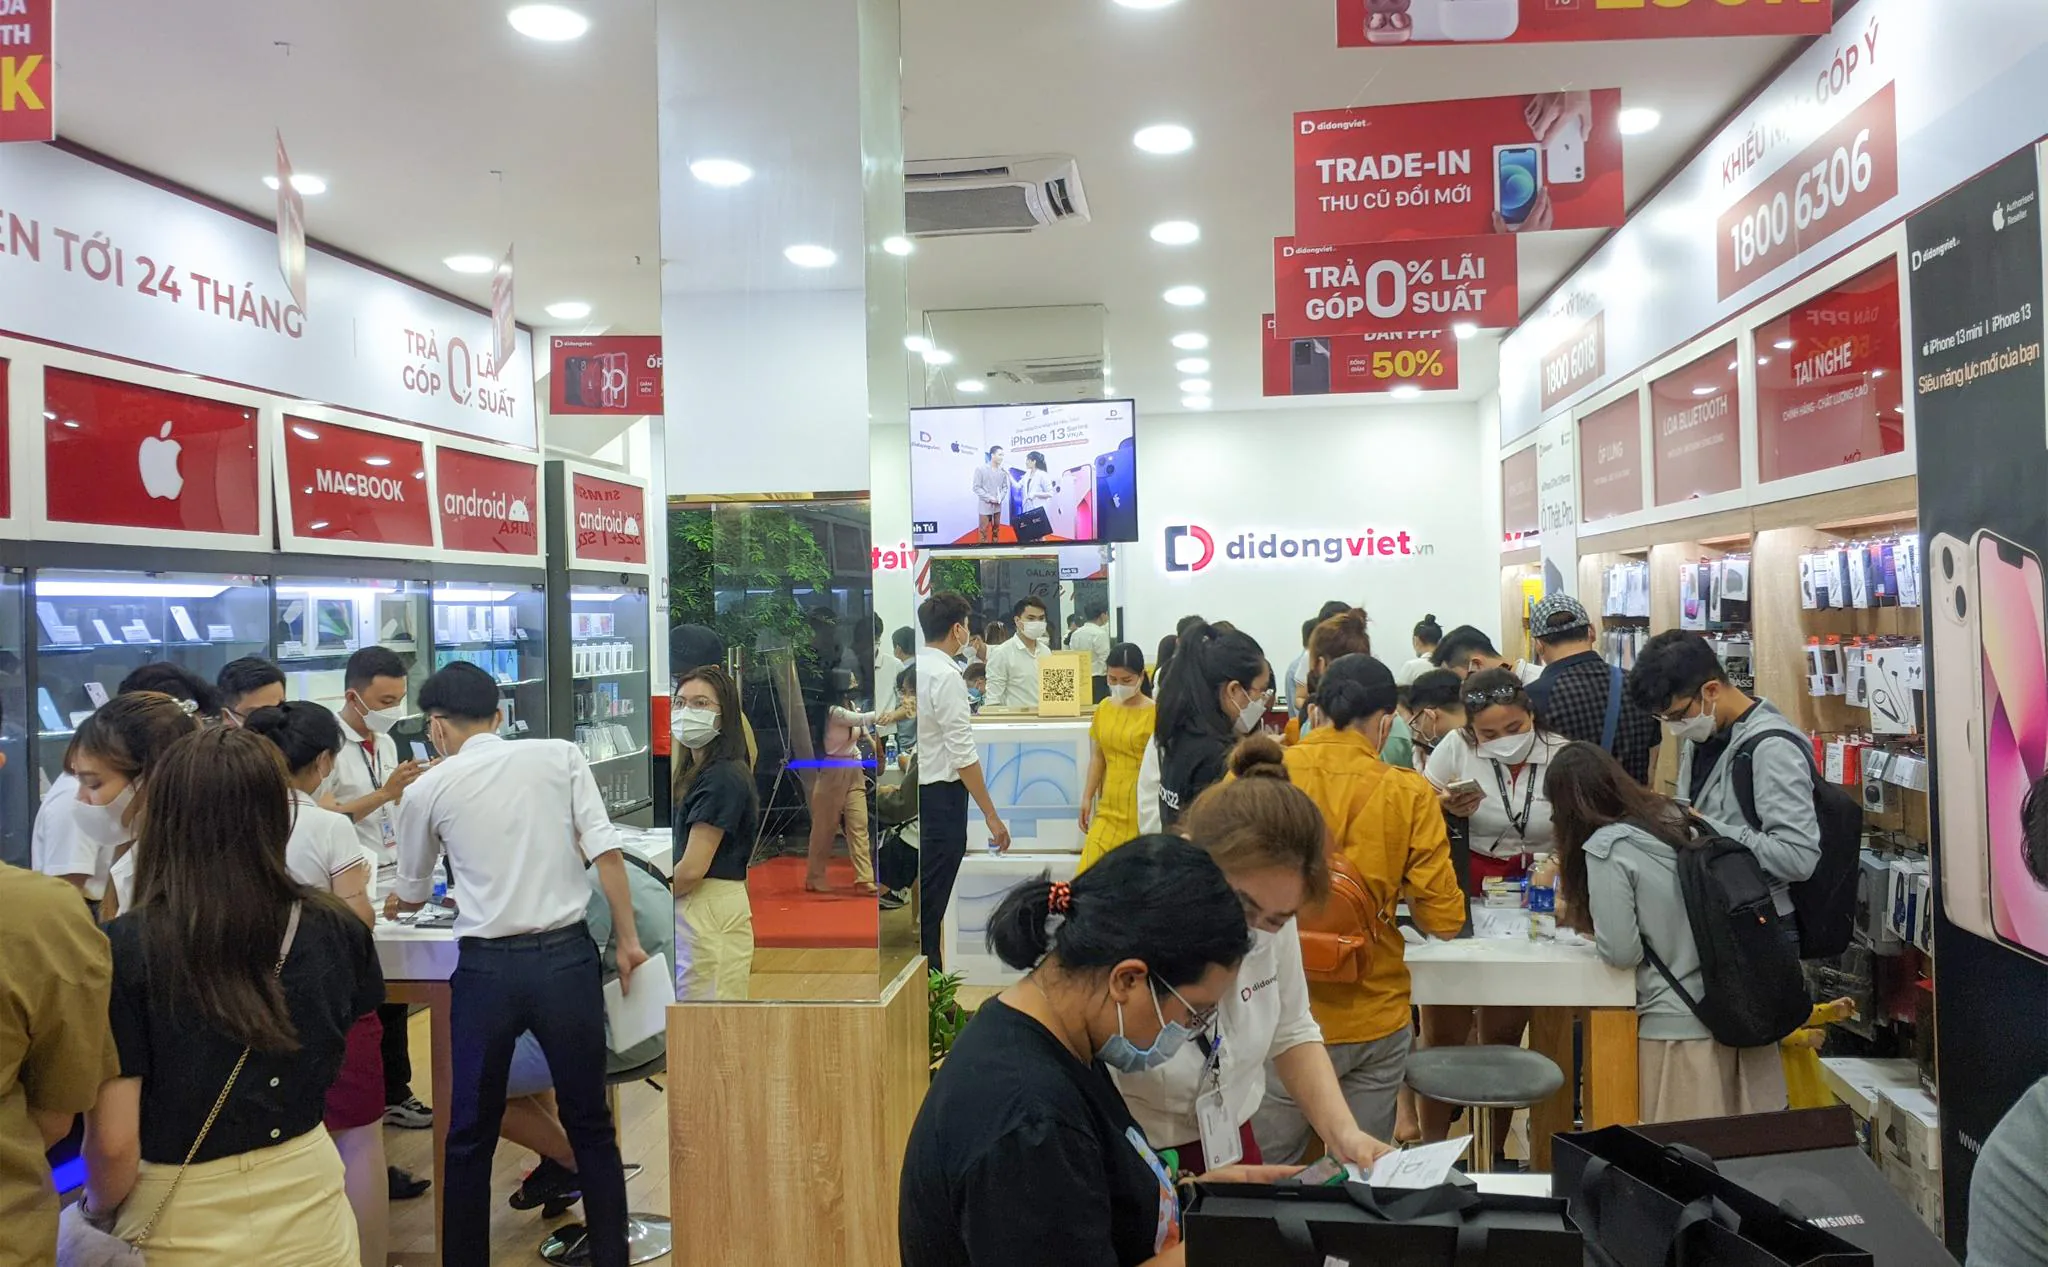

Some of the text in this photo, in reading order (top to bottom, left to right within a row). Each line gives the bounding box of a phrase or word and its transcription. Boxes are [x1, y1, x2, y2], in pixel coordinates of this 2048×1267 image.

[1722, 16, 1879, 189] KHIẾU GÓP Ý
[1315, 149, 1471, 184] TRADE-IN
[1318, 183, 1472, 212] THU CŨ ĐỔI MỚI
[1731, 128, 1872, 273] 1800 6306
[53, 230, 124, 287] TỚI
[136, 255, 182, 303] 24
[190, 271, 303, 339] THÁNG
[1304, 252, 1486, 319] TRẢ 0% LÃI
[1305, 281, 1487, 321] GÓP SUẤT
[403, 328, 441, 362] TRẢ
[1929, 335, 1956, 355] iPhone
[1956, 328, 1966, 345] 13
[1966, 321, 1983, 342] mini
[1991, 311, 2020, 333] iPhone
[2020, 303, 2032, 321] 13
[1371, 350, 1444, 379] 50%
[1545, 333, 1596, 396] 1800 6018
[1794, 341, 1852, 387] TAI NGHE
[1919, 342, 2040, 395] Siêu năng lực mới của bạn
[403, 365, 516, 419] GÓP SUẤT
[1678, 393, 1728, 430] BLUETOOTH
[1010, 433, 1047, 447] iPhone
[1049, 427, 1066, 441] 13
[315, 468, 405, 502] MACBOOK
[444, 487, 506, 520] android
[579, 507, 623, 534] android
[1226, 527, 1434, 563] didongviet.vn
[1806, 1214, 1865, 1229] MSUNG
